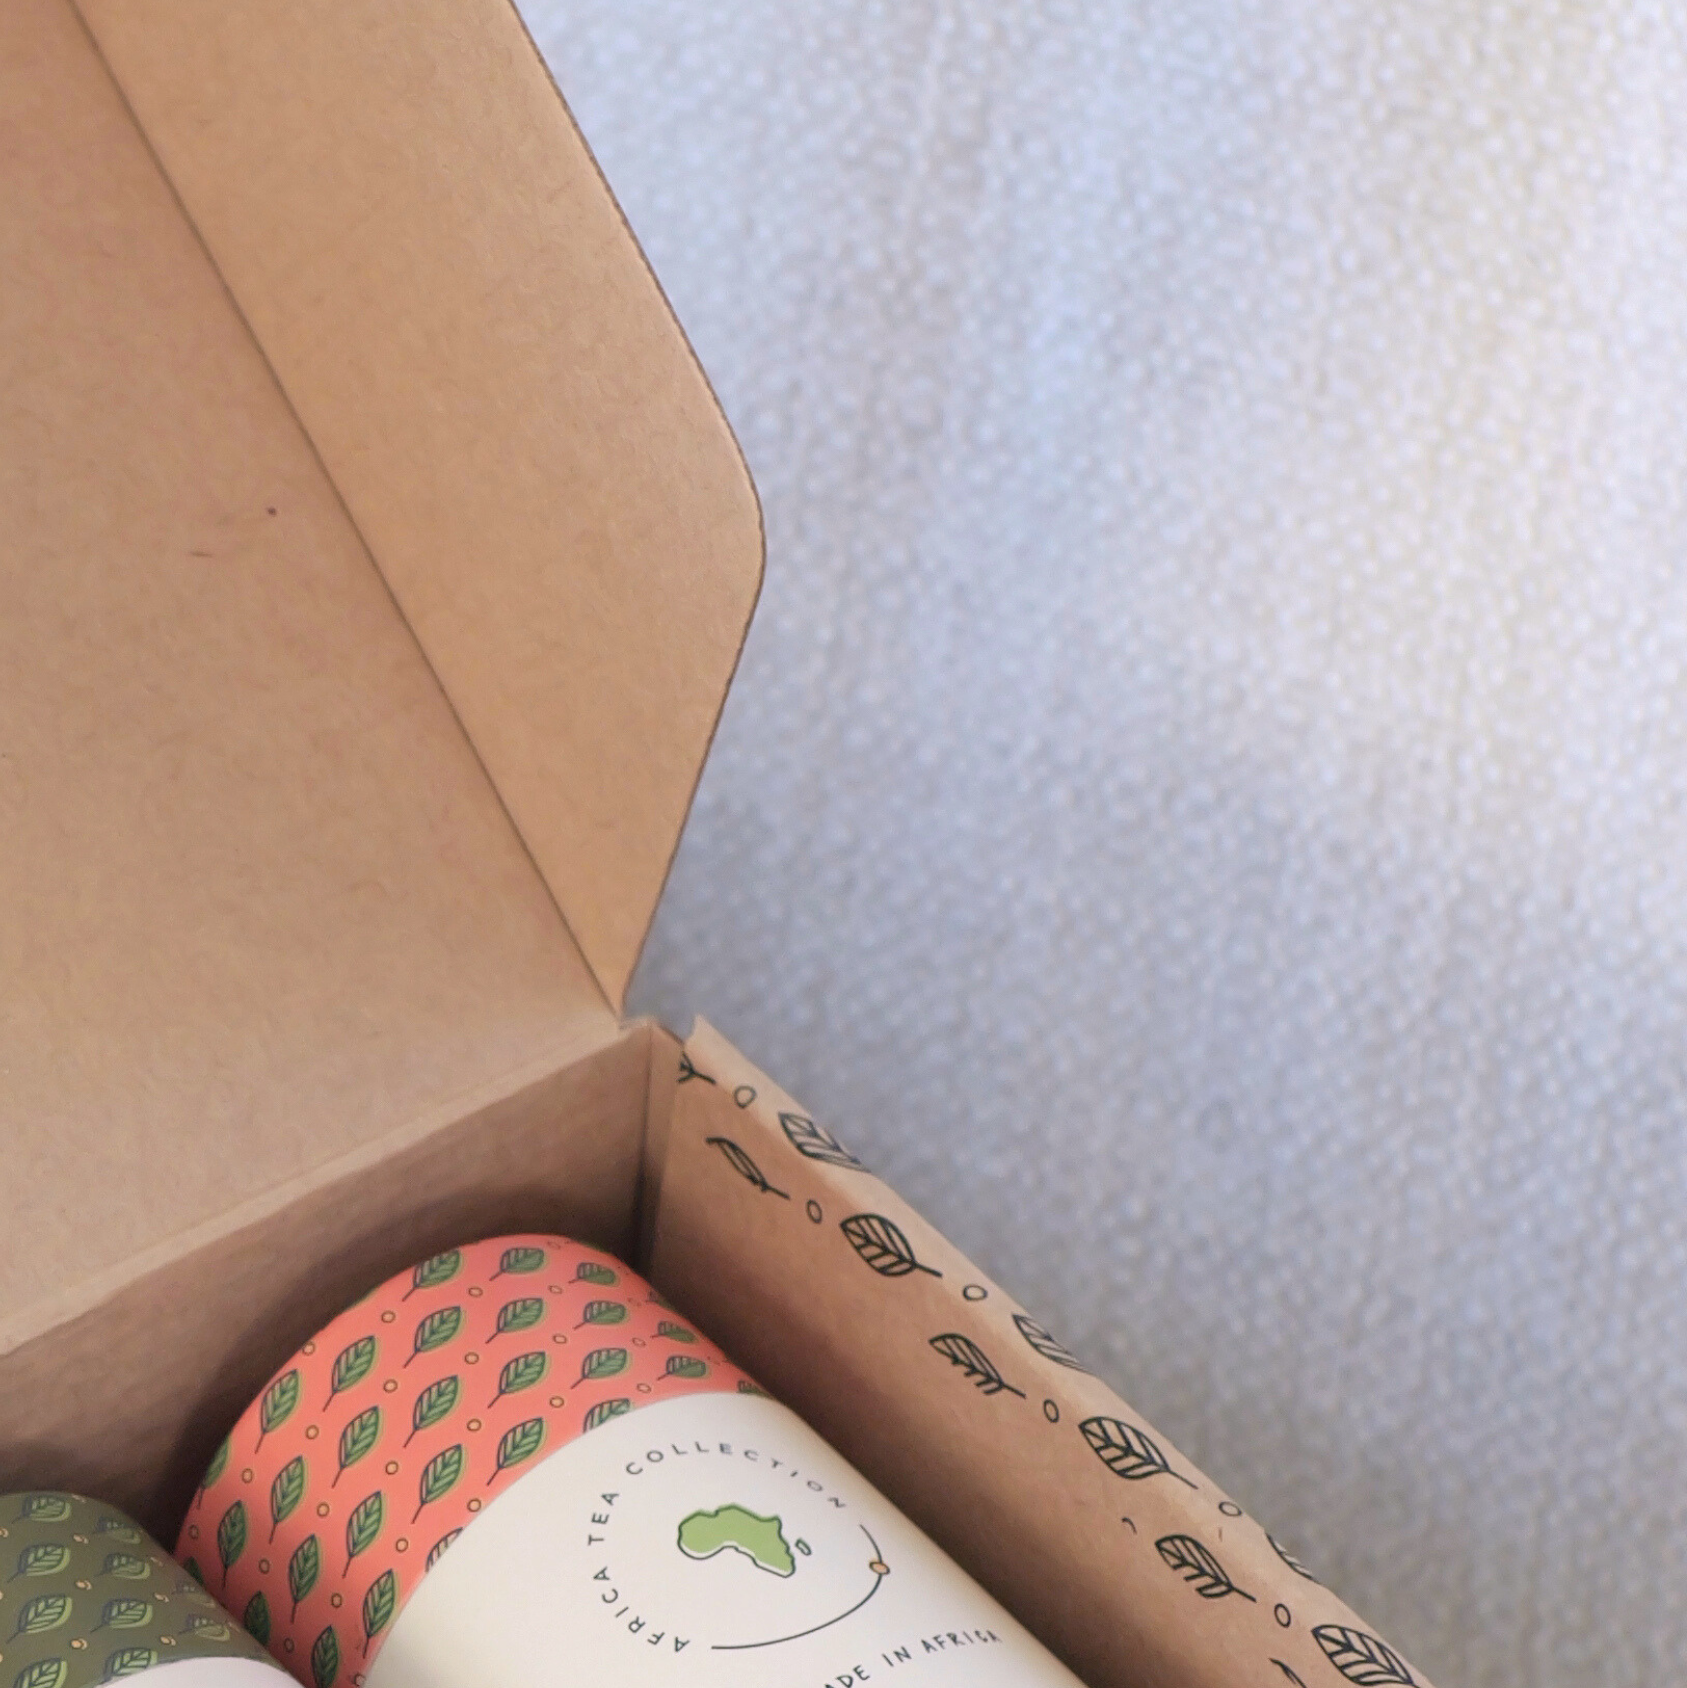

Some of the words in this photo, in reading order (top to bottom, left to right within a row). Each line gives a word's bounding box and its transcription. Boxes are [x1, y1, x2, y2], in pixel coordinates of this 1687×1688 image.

[626, 1441, 846, 1508] COLLECTION
[588, 1491, 619, 1545] TEA
[593, 1566, 690, 1653] AFRICA
[882, 1645, 911, 1667] IN
[921, 1628, 1002, 1654] AFRICA
